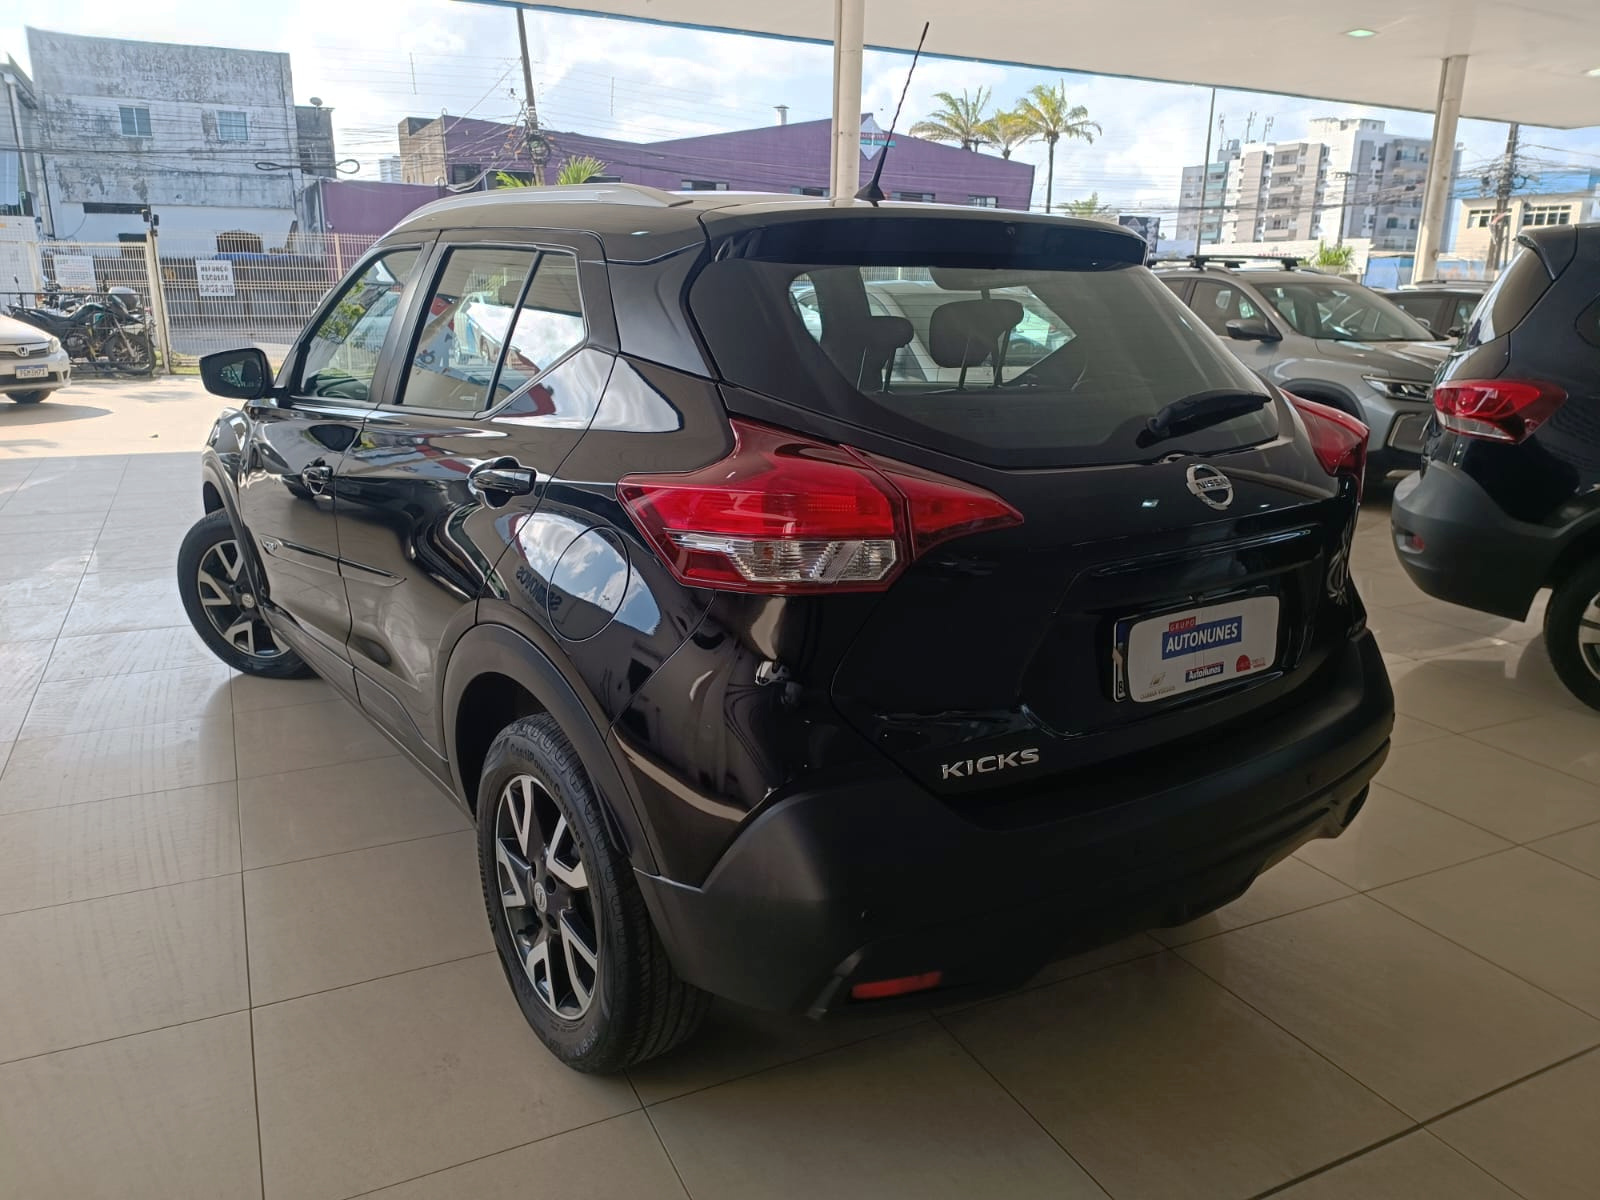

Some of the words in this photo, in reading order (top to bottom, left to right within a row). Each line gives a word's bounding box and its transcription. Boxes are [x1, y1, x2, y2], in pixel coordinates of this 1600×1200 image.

[1196, 478, 1229, 490] NISSAN
[1169, 620, 1195, 632] GRUPO
[1166, 622, 1239, 653] AUTONUNES
[940, 748, 1039, 779] KICKS
